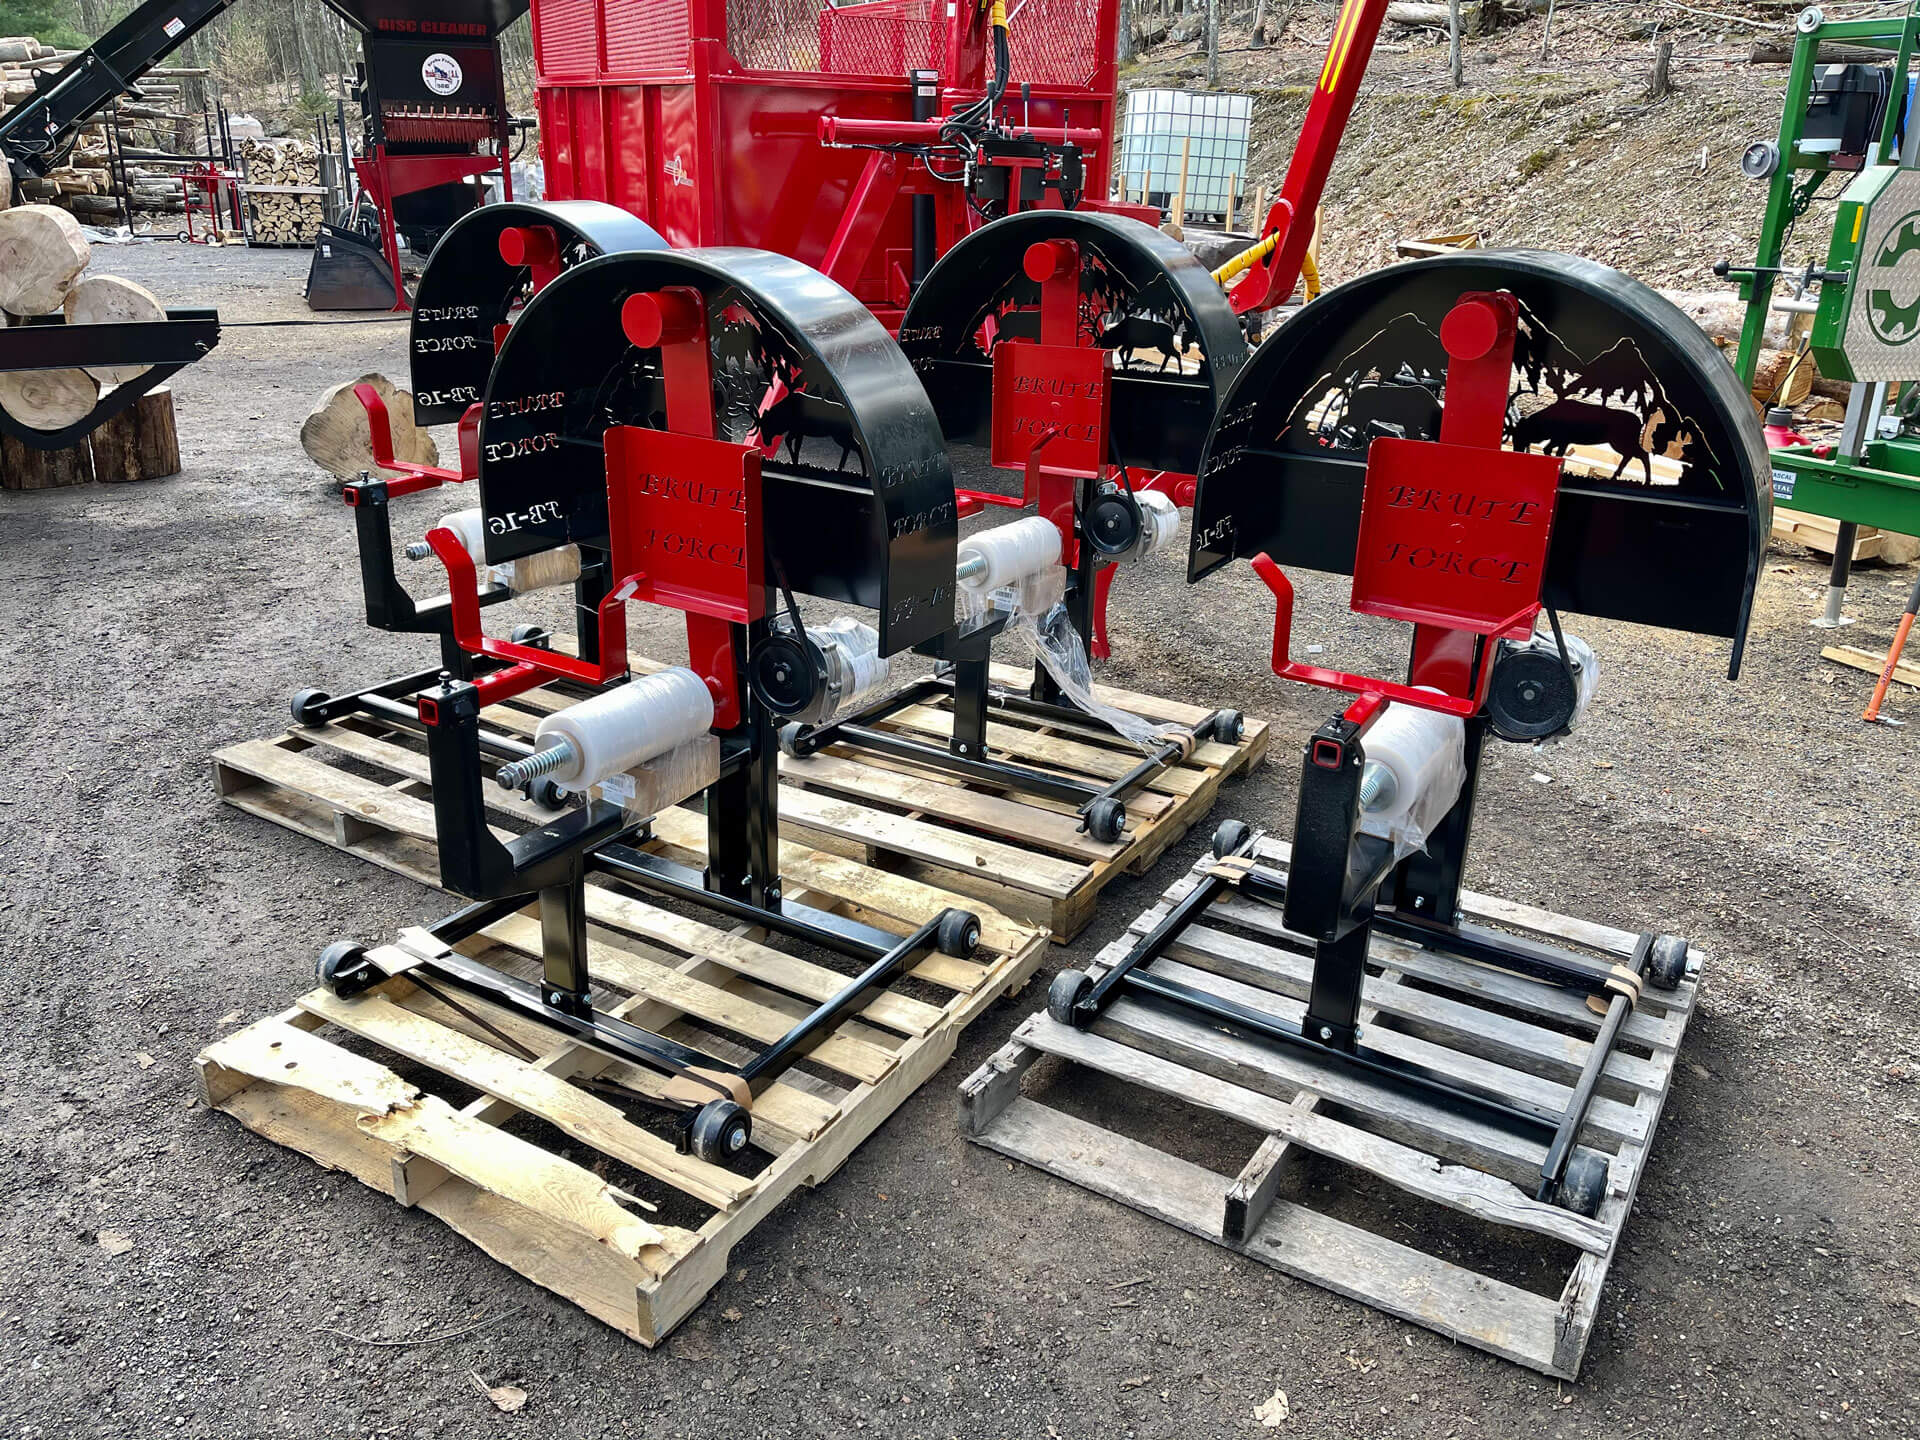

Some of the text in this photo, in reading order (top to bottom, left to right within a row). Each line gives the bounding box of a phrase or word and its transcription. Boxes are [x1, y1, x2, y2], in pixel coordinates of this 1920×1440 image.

[378, 18, 488, 36] DISC CLEANER
[1014, 376, 1101, 399] BRUTE
[1387, 485, 1540, 525] BRUTE
[1379, 543, 1530, 584] FORCE
